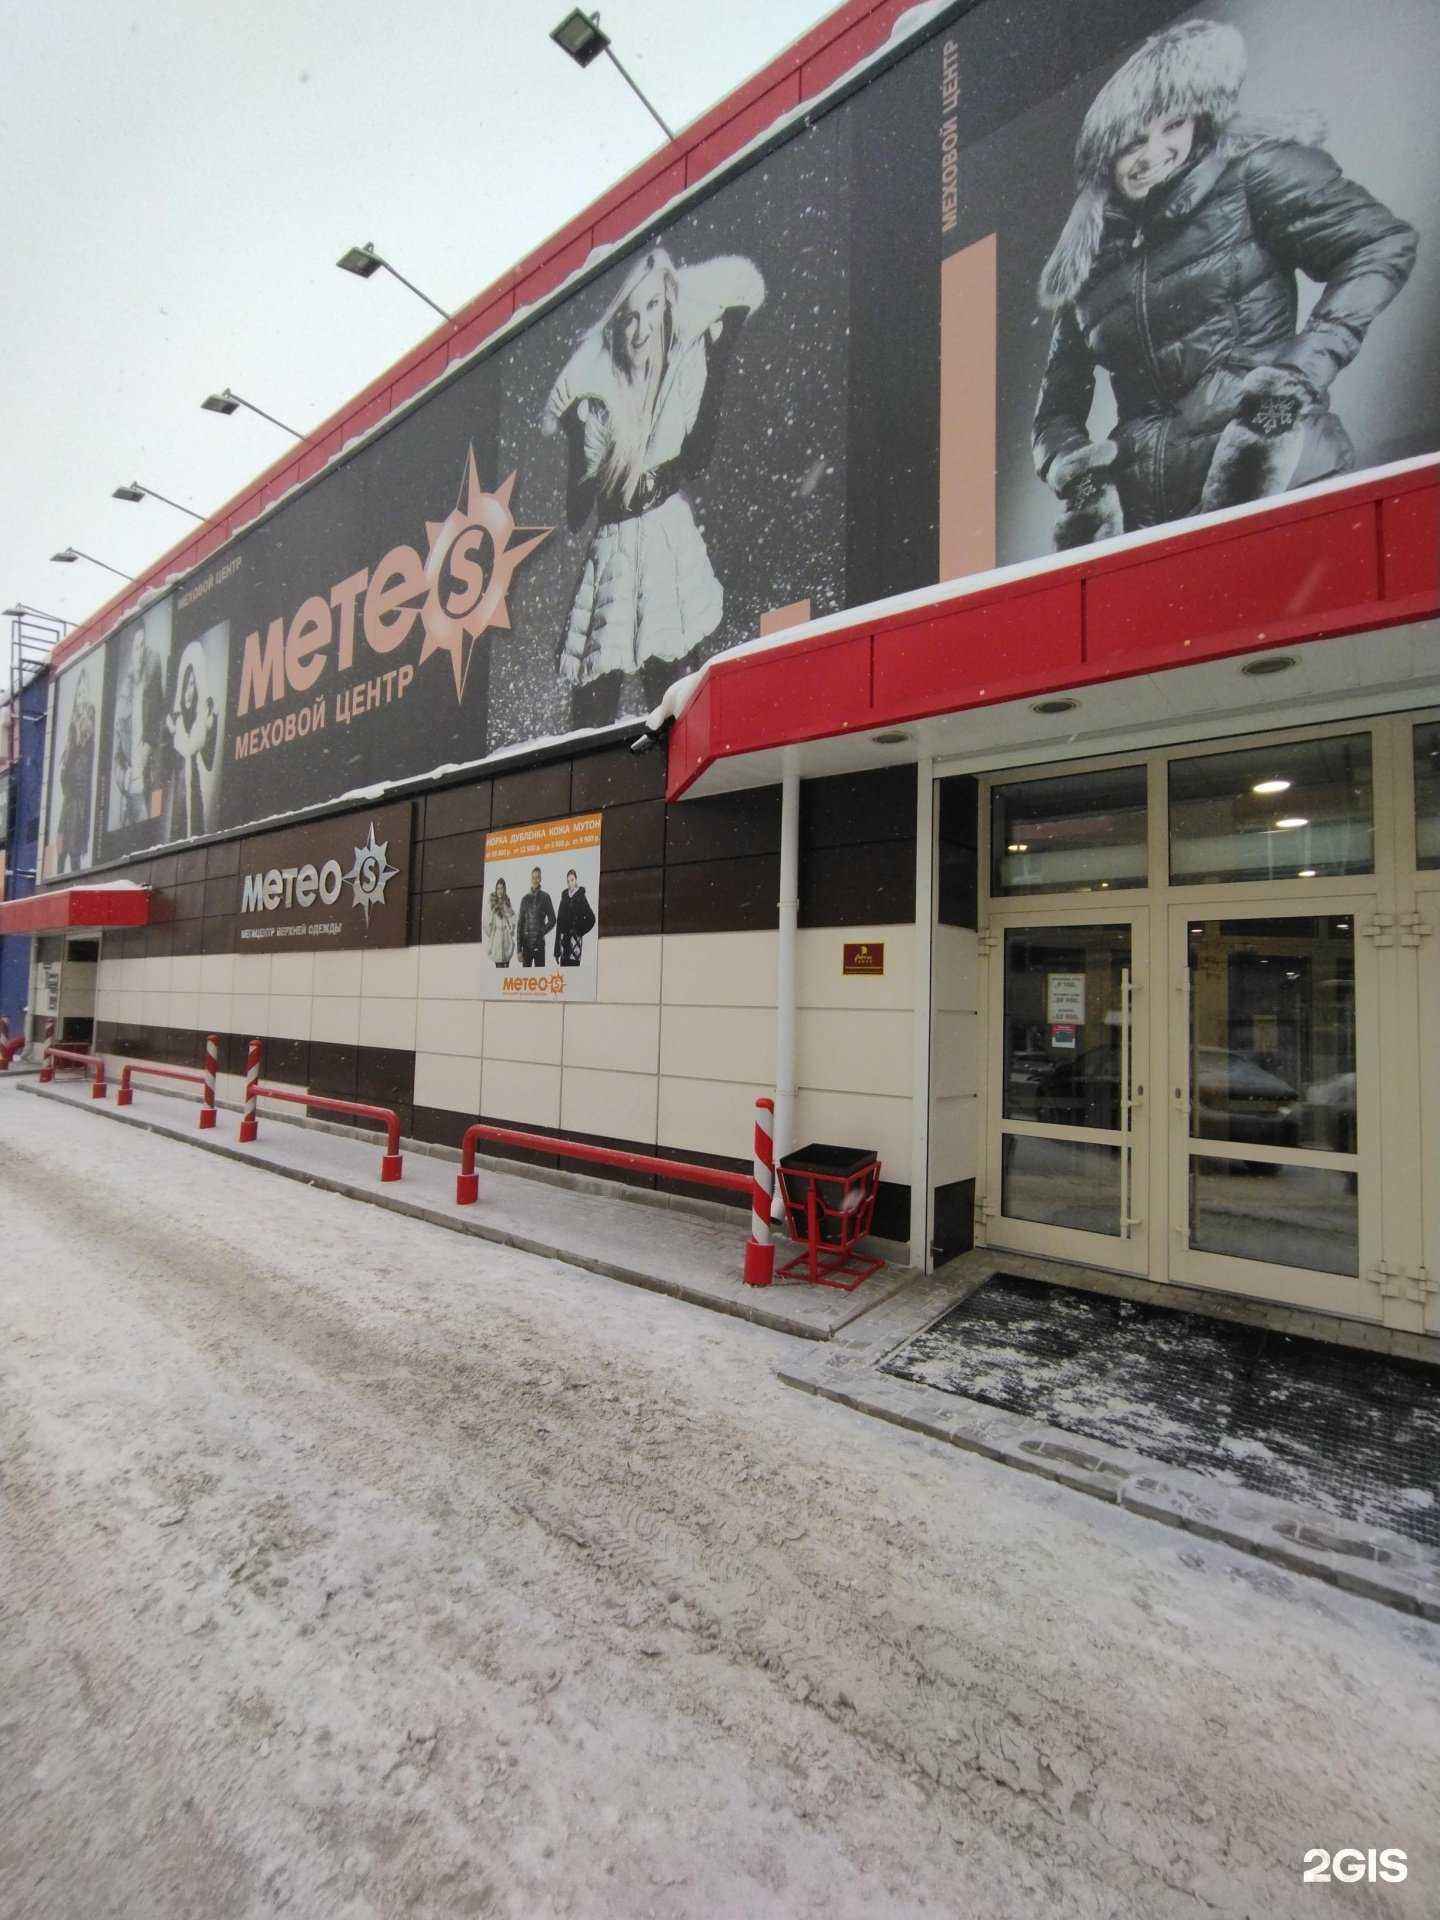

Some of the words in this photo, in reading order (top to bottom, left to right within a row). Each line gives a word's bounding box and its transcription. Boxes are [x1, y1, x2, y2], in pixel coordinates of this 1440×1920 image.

[943, 39, 960, 114] ЦЕНТР
[939, 116, 958, 233] МЕХОВОЙ
[215, 556, 242, 585] ЦЕНТР
[234, 695, 326, 761] МЕХОВОЙ
[335, 665, 414, 725] ЦЕНТР
[549, 824, 570, 836] КОЖА
[573, 819, 601, 832] МУТОН
[308, 921, 342, 936] ОДЕЖДЫ
